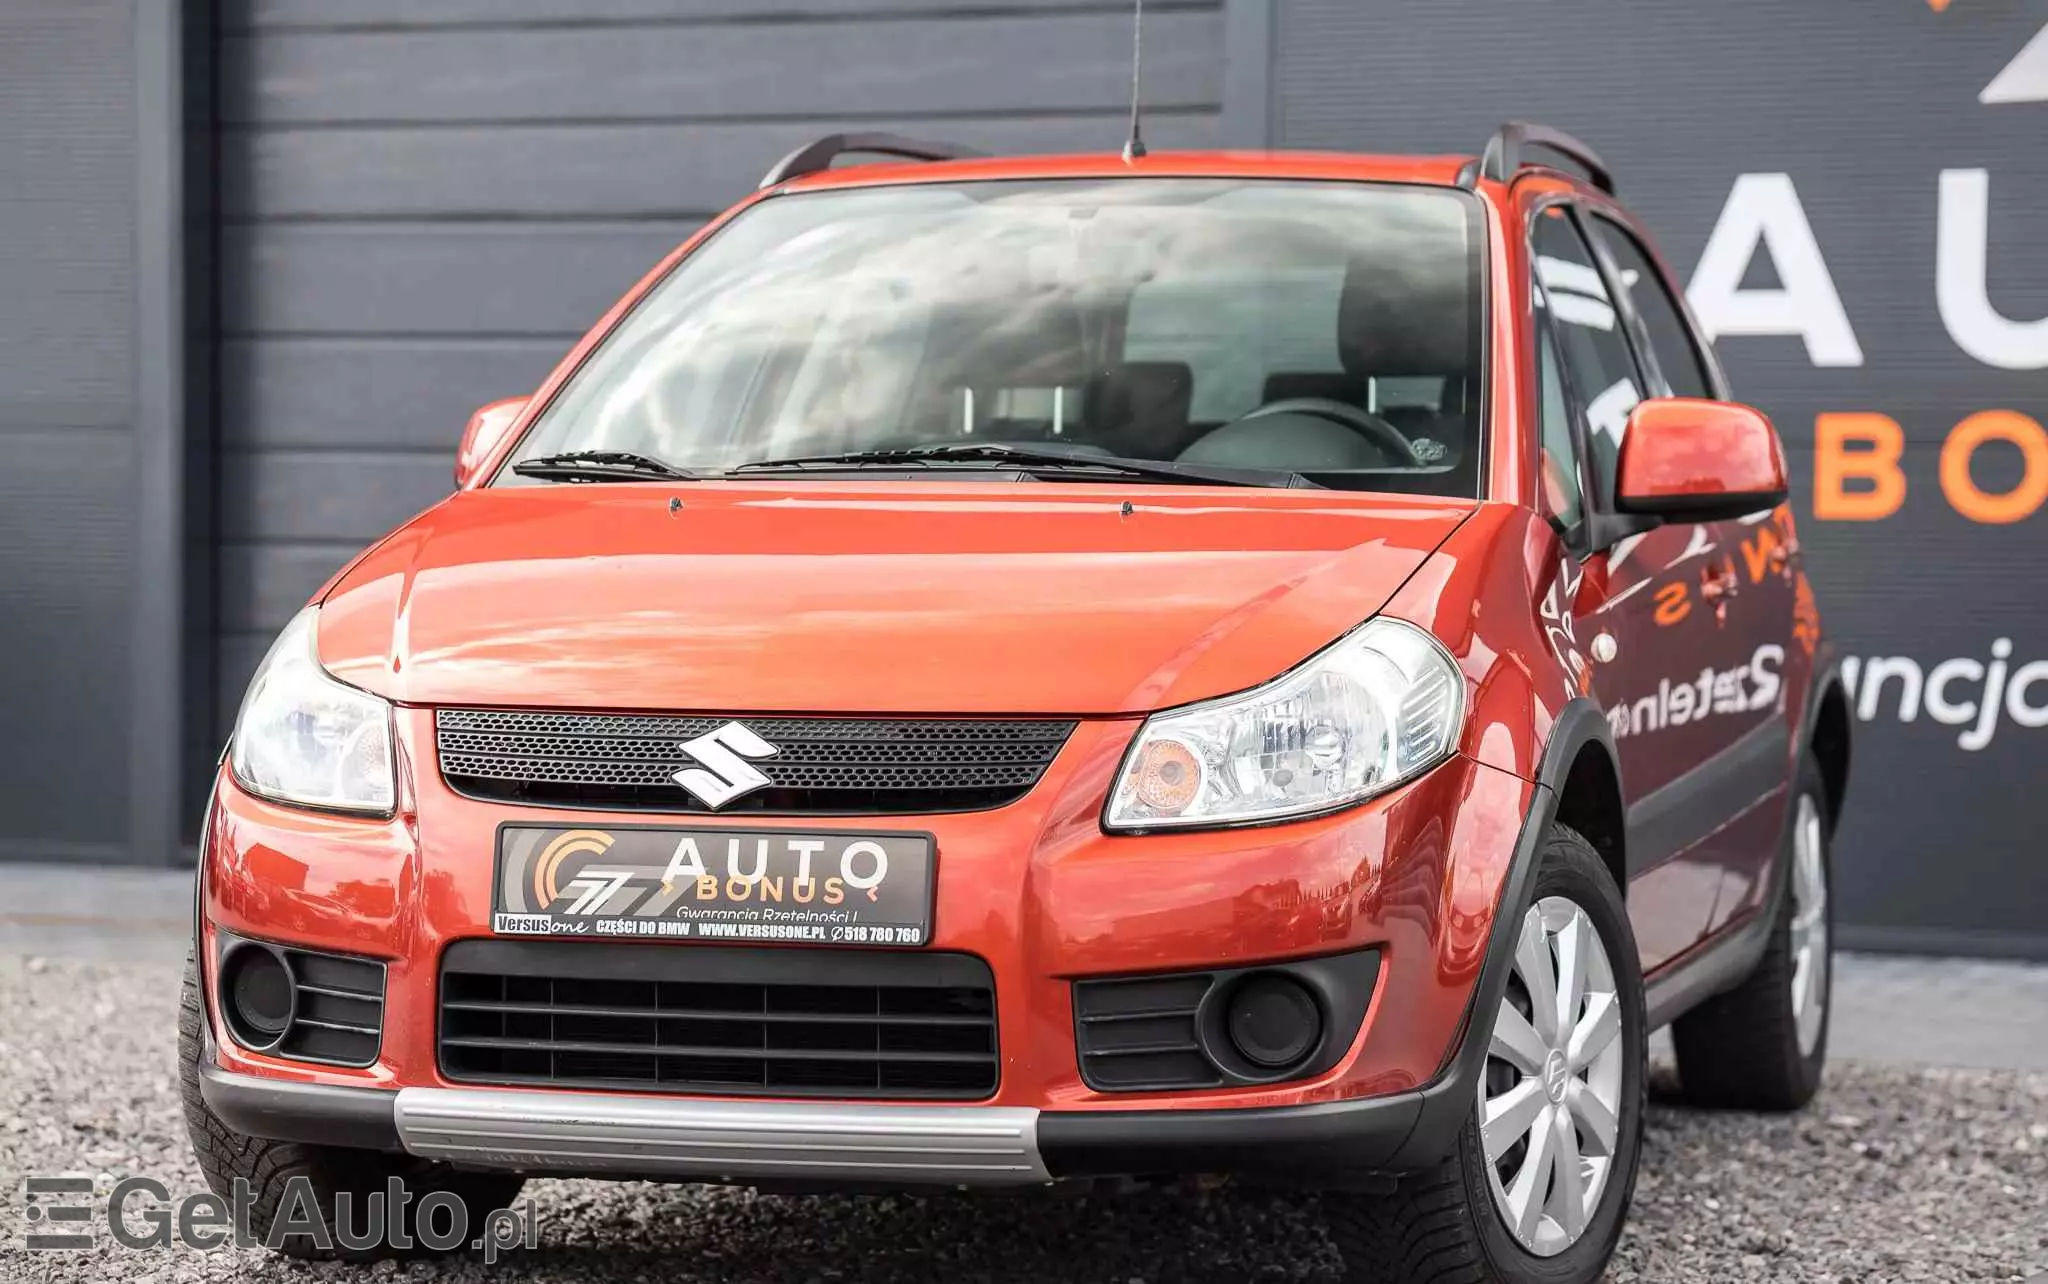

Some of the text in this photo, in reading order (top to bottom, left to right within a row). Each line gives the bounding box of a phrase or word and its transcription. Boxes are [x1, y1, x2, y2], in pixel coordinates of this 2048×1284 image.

[661, 837, 888, 889] AUTO
[696, 875, 847, 905] BONUS
[596, 918, 637, 936] CZĘŚCI
[639, 921, 656, 935] DO
[658, 921, 691, 936] BMW
[699, 922, 826, 940] WWW.VERSUSONE.PL
